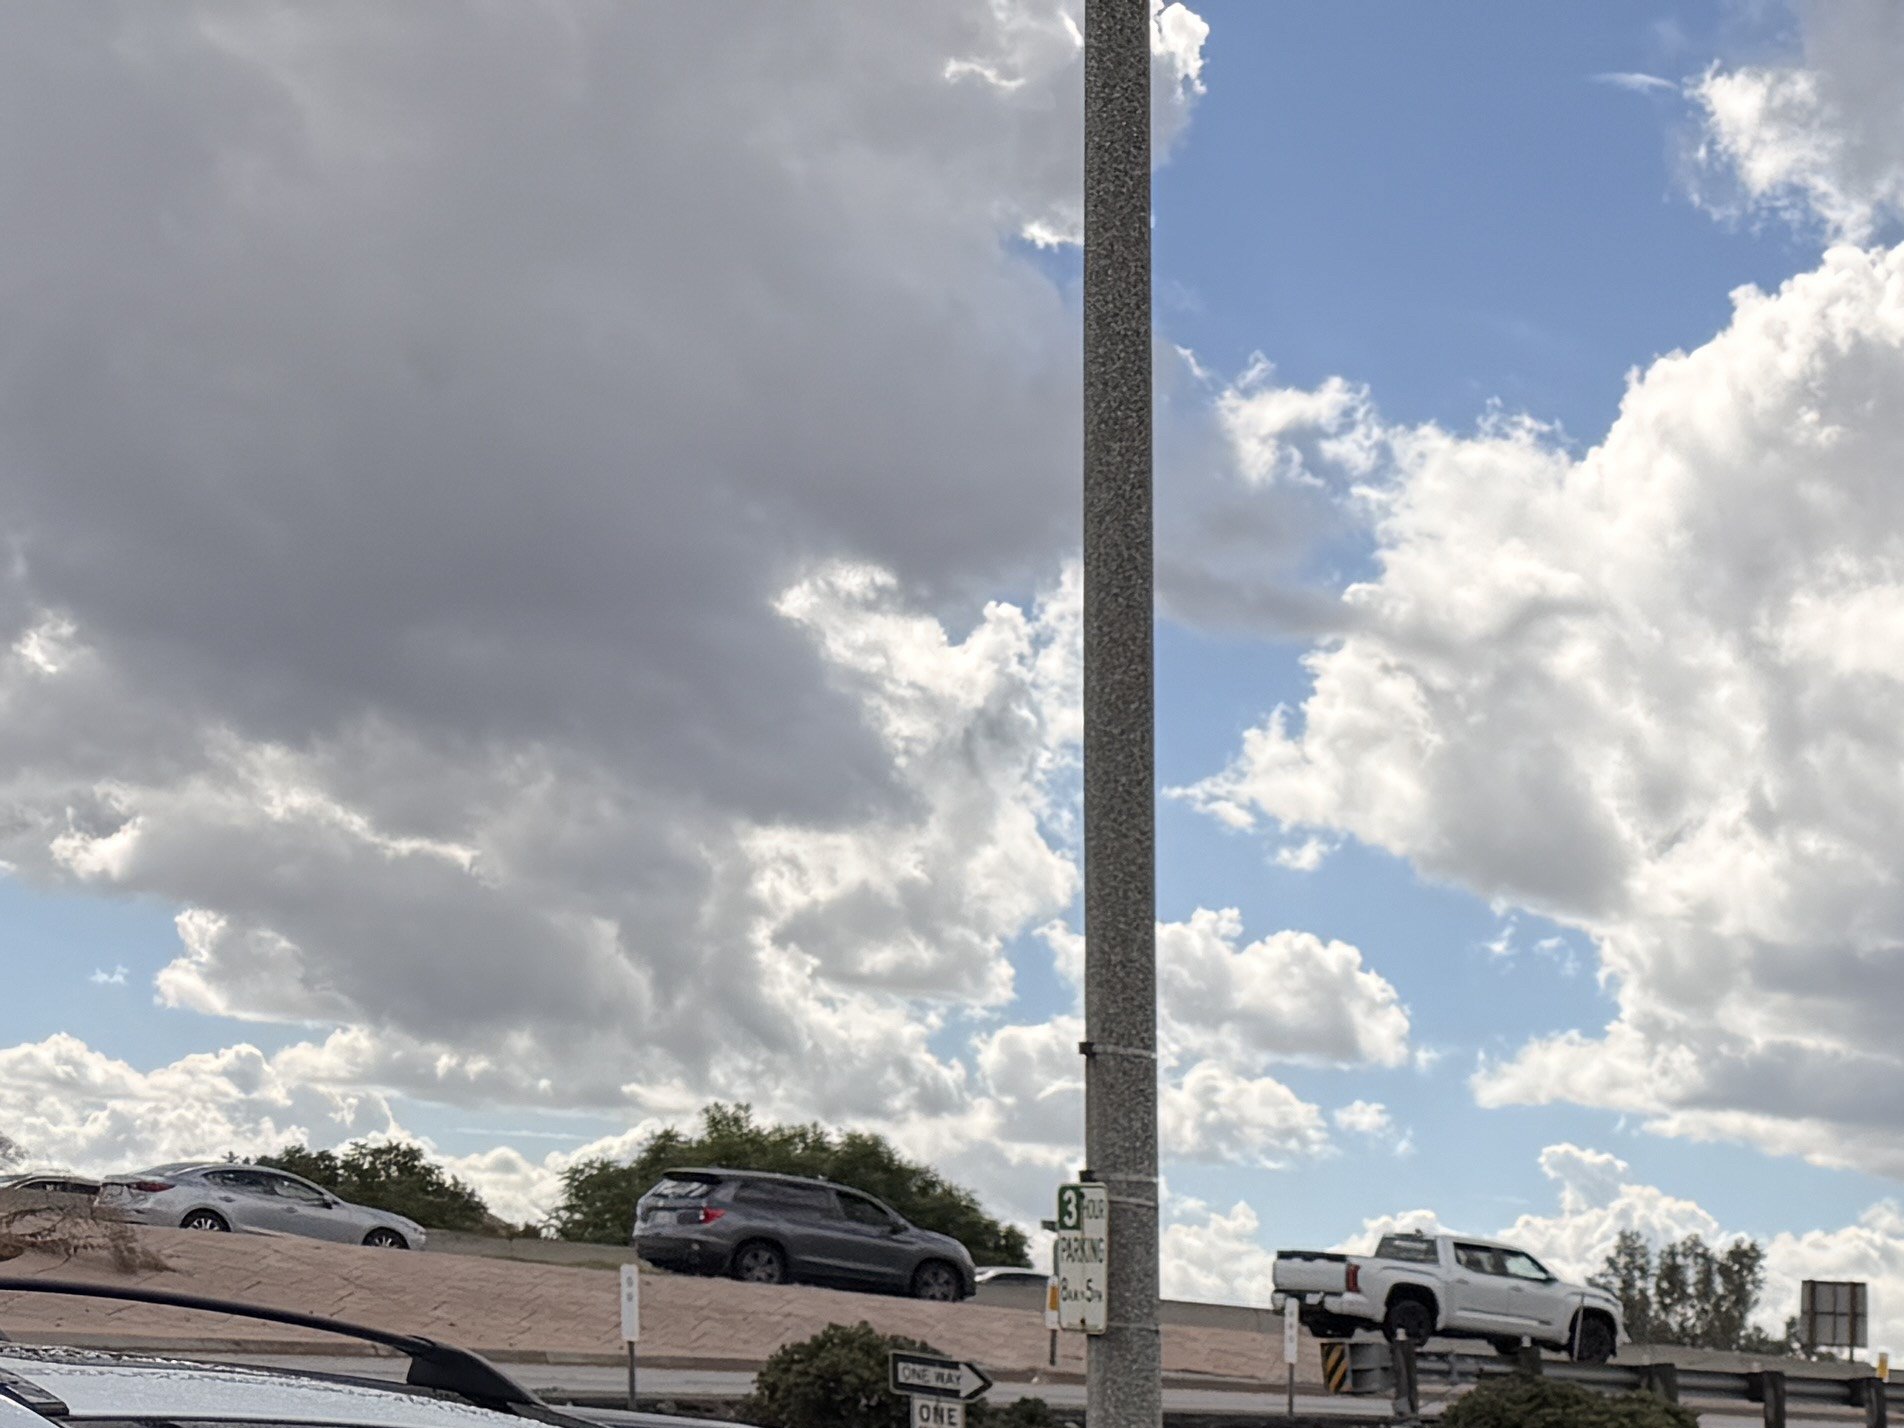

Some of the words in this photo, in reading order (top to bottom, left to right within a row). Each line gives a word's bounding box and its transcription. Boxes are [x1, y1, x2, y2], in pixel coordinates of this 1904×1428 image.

[1063, 1190, 1078, 1227] 3
[1082, 1198, 1104, 1219] HOUR
[1060, 1237, 1104, 1263] PARKING
[902, 1366, 928, 1383] ONE
[935, 1371, 962, 1384] WAY
[919, 1404, 957, 1426] ONE
